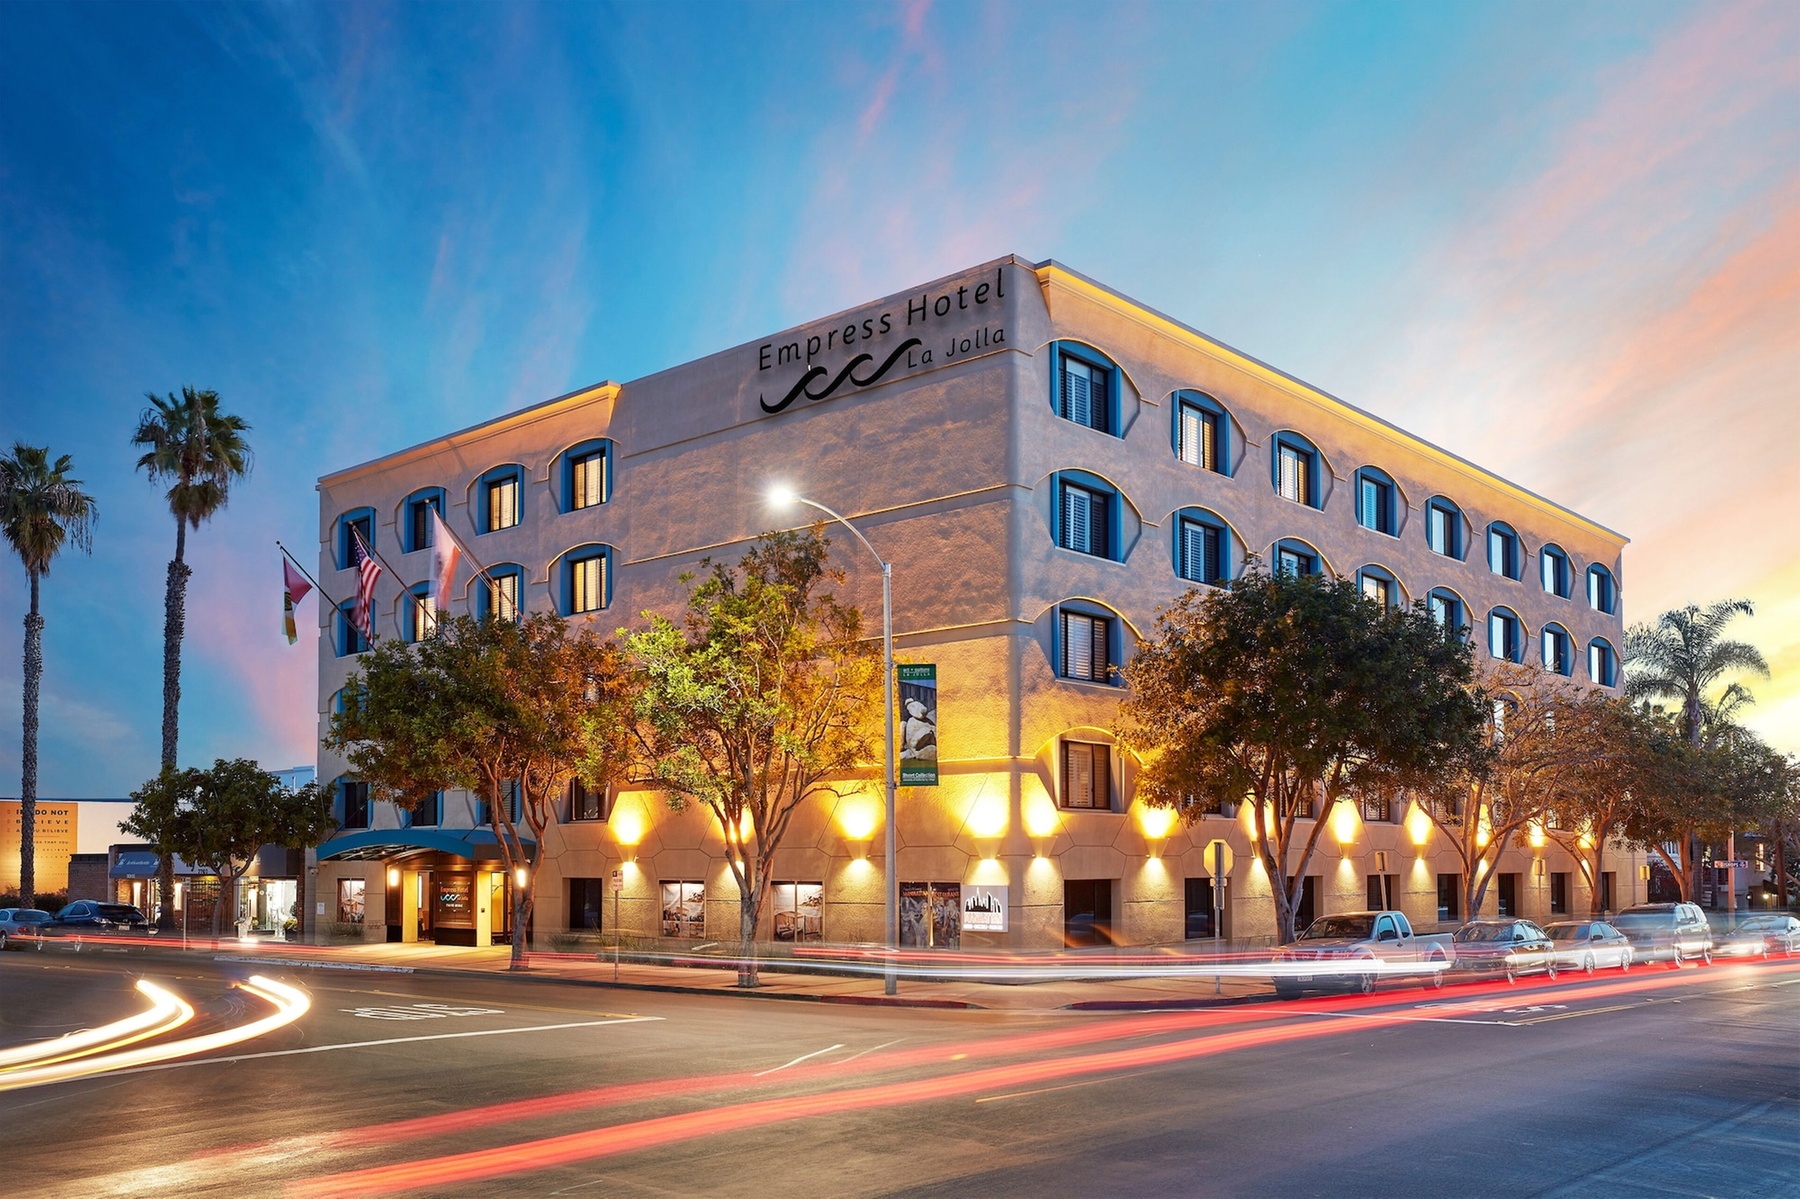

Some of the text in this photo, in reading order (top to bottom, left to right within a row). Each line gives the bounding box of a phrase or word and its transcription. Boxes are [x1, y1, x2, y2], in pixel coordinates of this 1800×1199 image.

[758, 267, 1005, 371] Empress Hotel
[907, 328, 1006, 369] La Jolla
